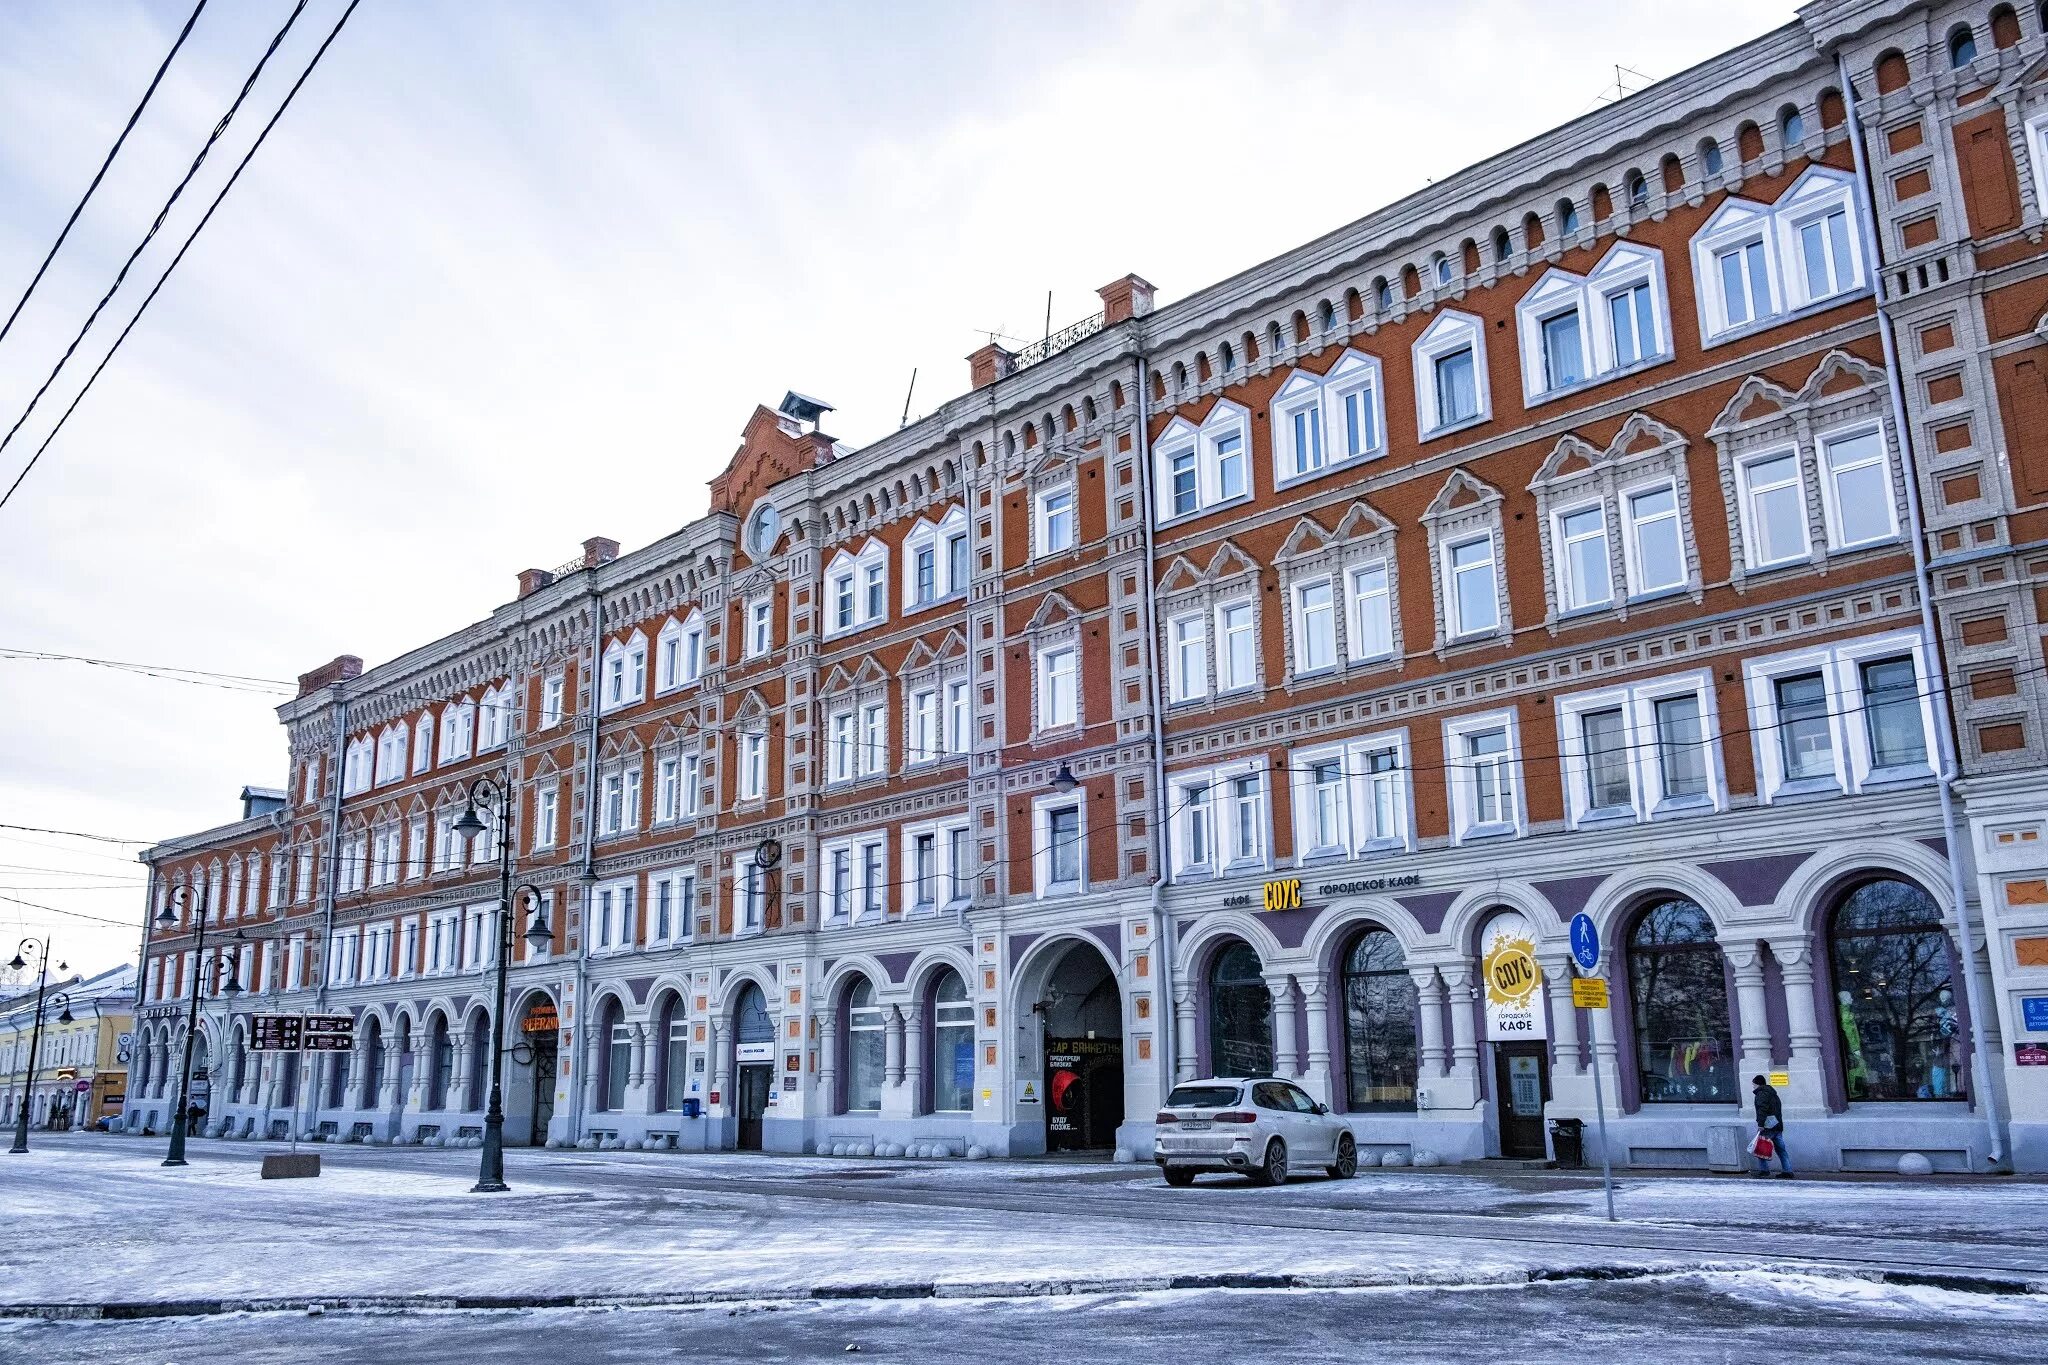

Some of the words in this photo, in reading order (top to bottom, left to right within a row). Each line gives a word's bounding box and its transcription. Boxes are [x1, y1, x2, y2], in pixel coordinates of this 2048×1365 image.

[1223, 895, 1250, 907] КАФЕ
[1264, 879, 1303, 911] СОУС
[1319, 879, 1385, 895] ГОРОДСКОЕ
[1388, 875, 1420, 888] КАФЕ
[1496, 956, 1532, 990] СОУС
[1499, 1021, 1532, 1031] КАФЕ
[1052, 1116, 1067, 1124] БУДУ
